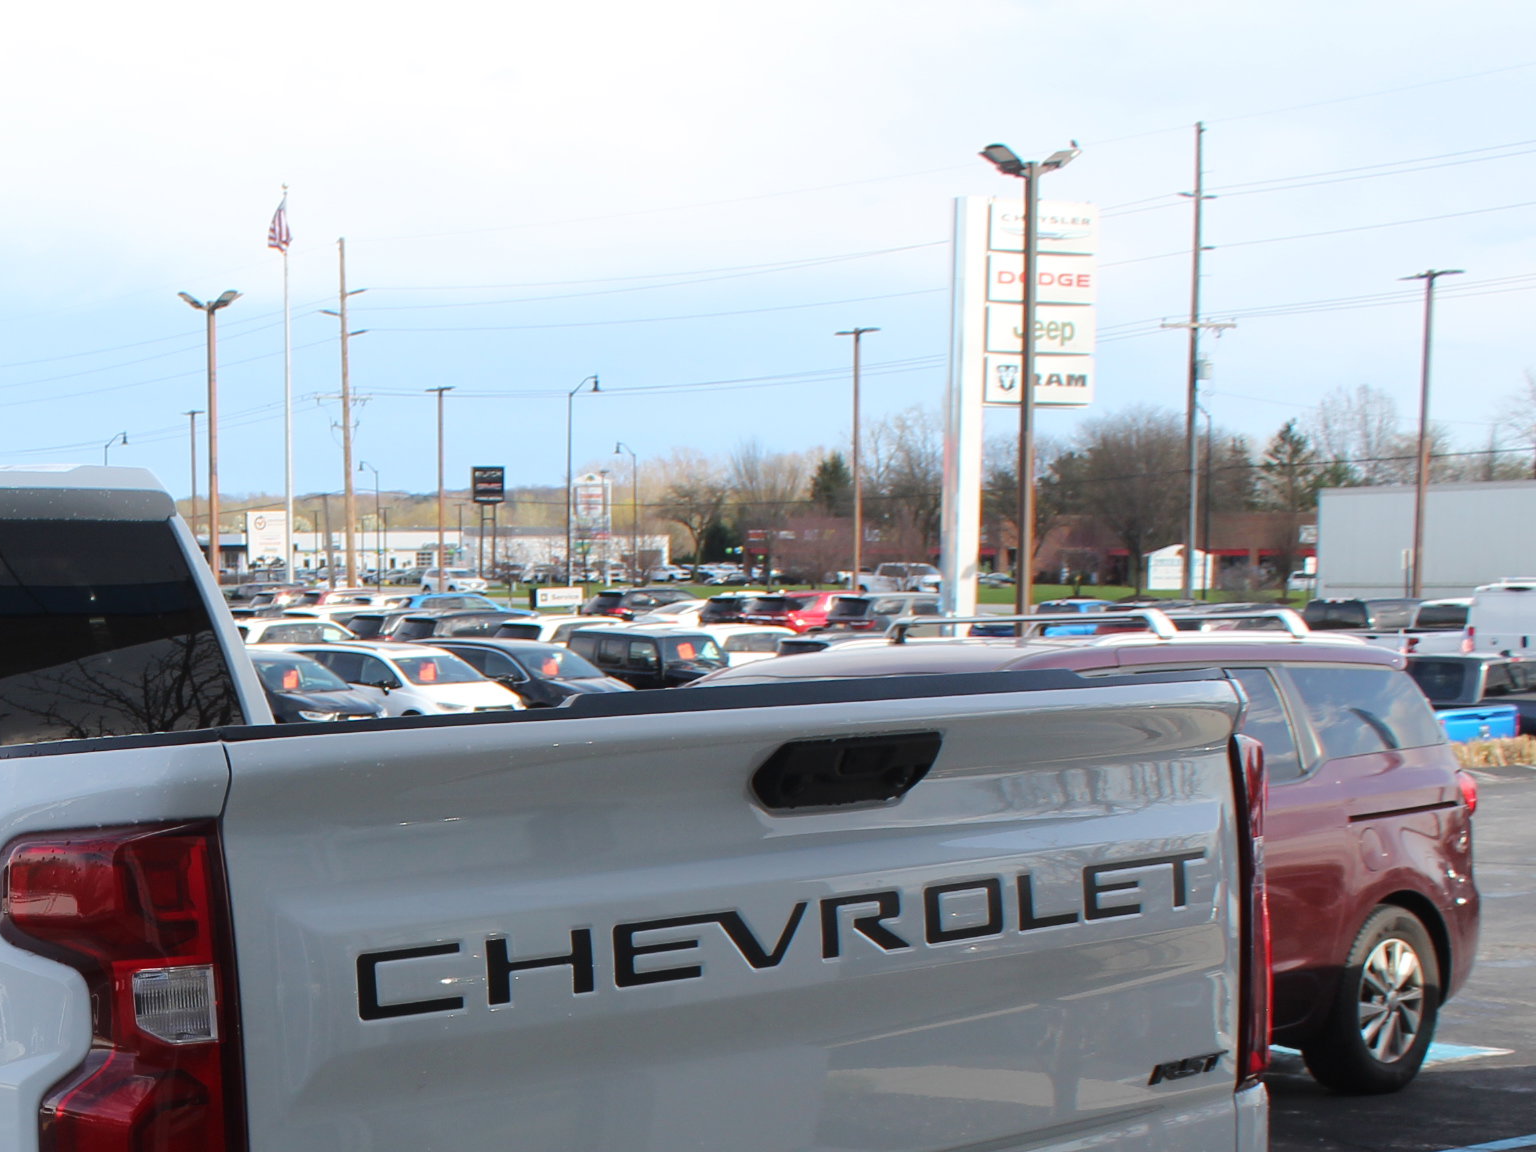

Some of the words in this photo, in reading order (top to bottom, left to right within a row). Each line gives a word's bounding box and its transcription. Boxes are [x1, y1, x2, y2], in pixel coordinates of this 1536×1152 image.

[1000, 213, 1092, 225] CHYSLER
[356, 850, 1207, 1021] CHEVROLET
[1147, 1049, 1229, 1086] RST
